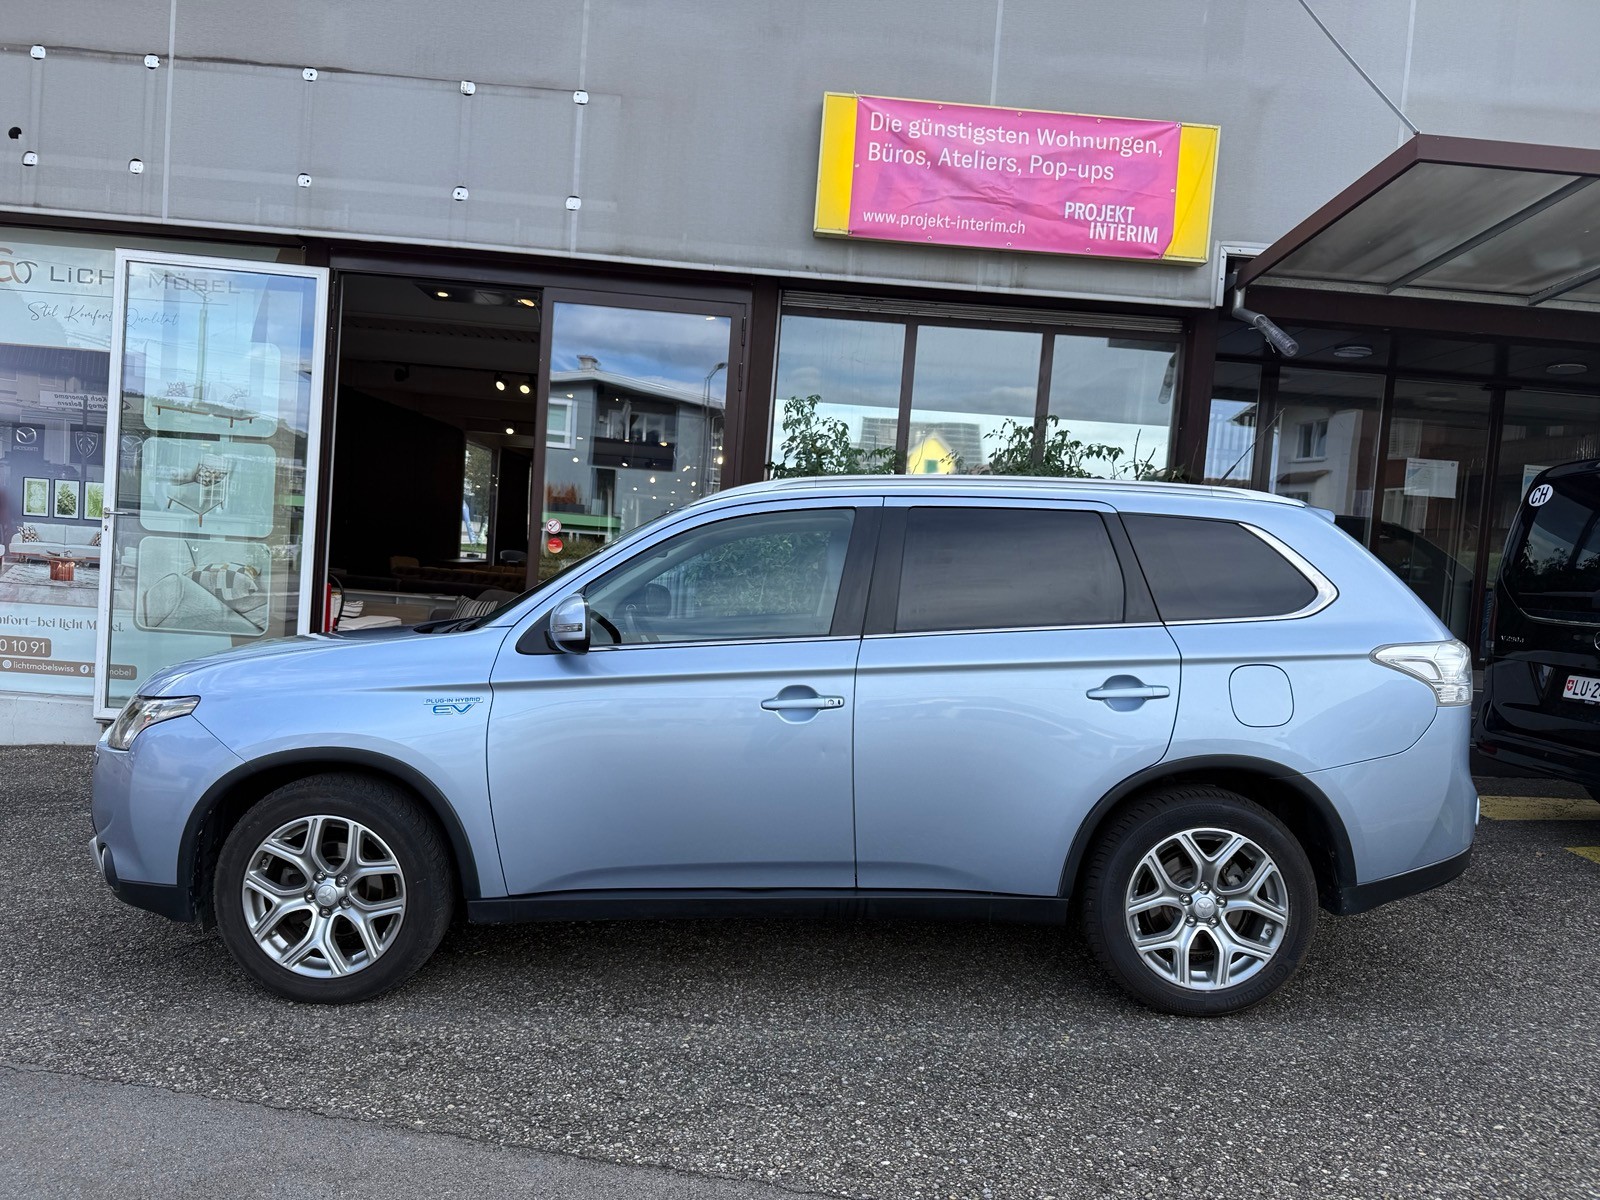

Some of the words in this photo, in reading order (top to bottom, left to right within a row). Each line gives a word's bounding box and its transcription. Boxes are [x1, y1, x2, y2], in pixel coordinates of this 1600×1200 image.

[870, 111, 902, 133] Die
[908, 118, 1030, 146] günstigsten
[1037, 128, 1163, 158] Wohnungen,
[868, 141, 931, 170] Büros,
[938, 147, 1022, 177] Ateliers,
[1029, 154, 1115, 184] Pop-ups
[862, 211, 1026, 235] www.projekt-interim.ch
[1064, 201, 1136, 224] PROJEKT
[1089, 222, 1159, 244] INTERIM
[50, 265, 134, 285] LiCH
[148, 272, 241, 294] MÖBEL
[27, 301, 59, 321] Stil
[1531, 487, 1550, 505] CH
[86, 619, 124, 632] Mel.
[11, 640, 28, 653] 10
[30, 641, 46, 654] 91
[1572, 679, 1600, 699] LU·2
[432, 703, 473, 714] EV
